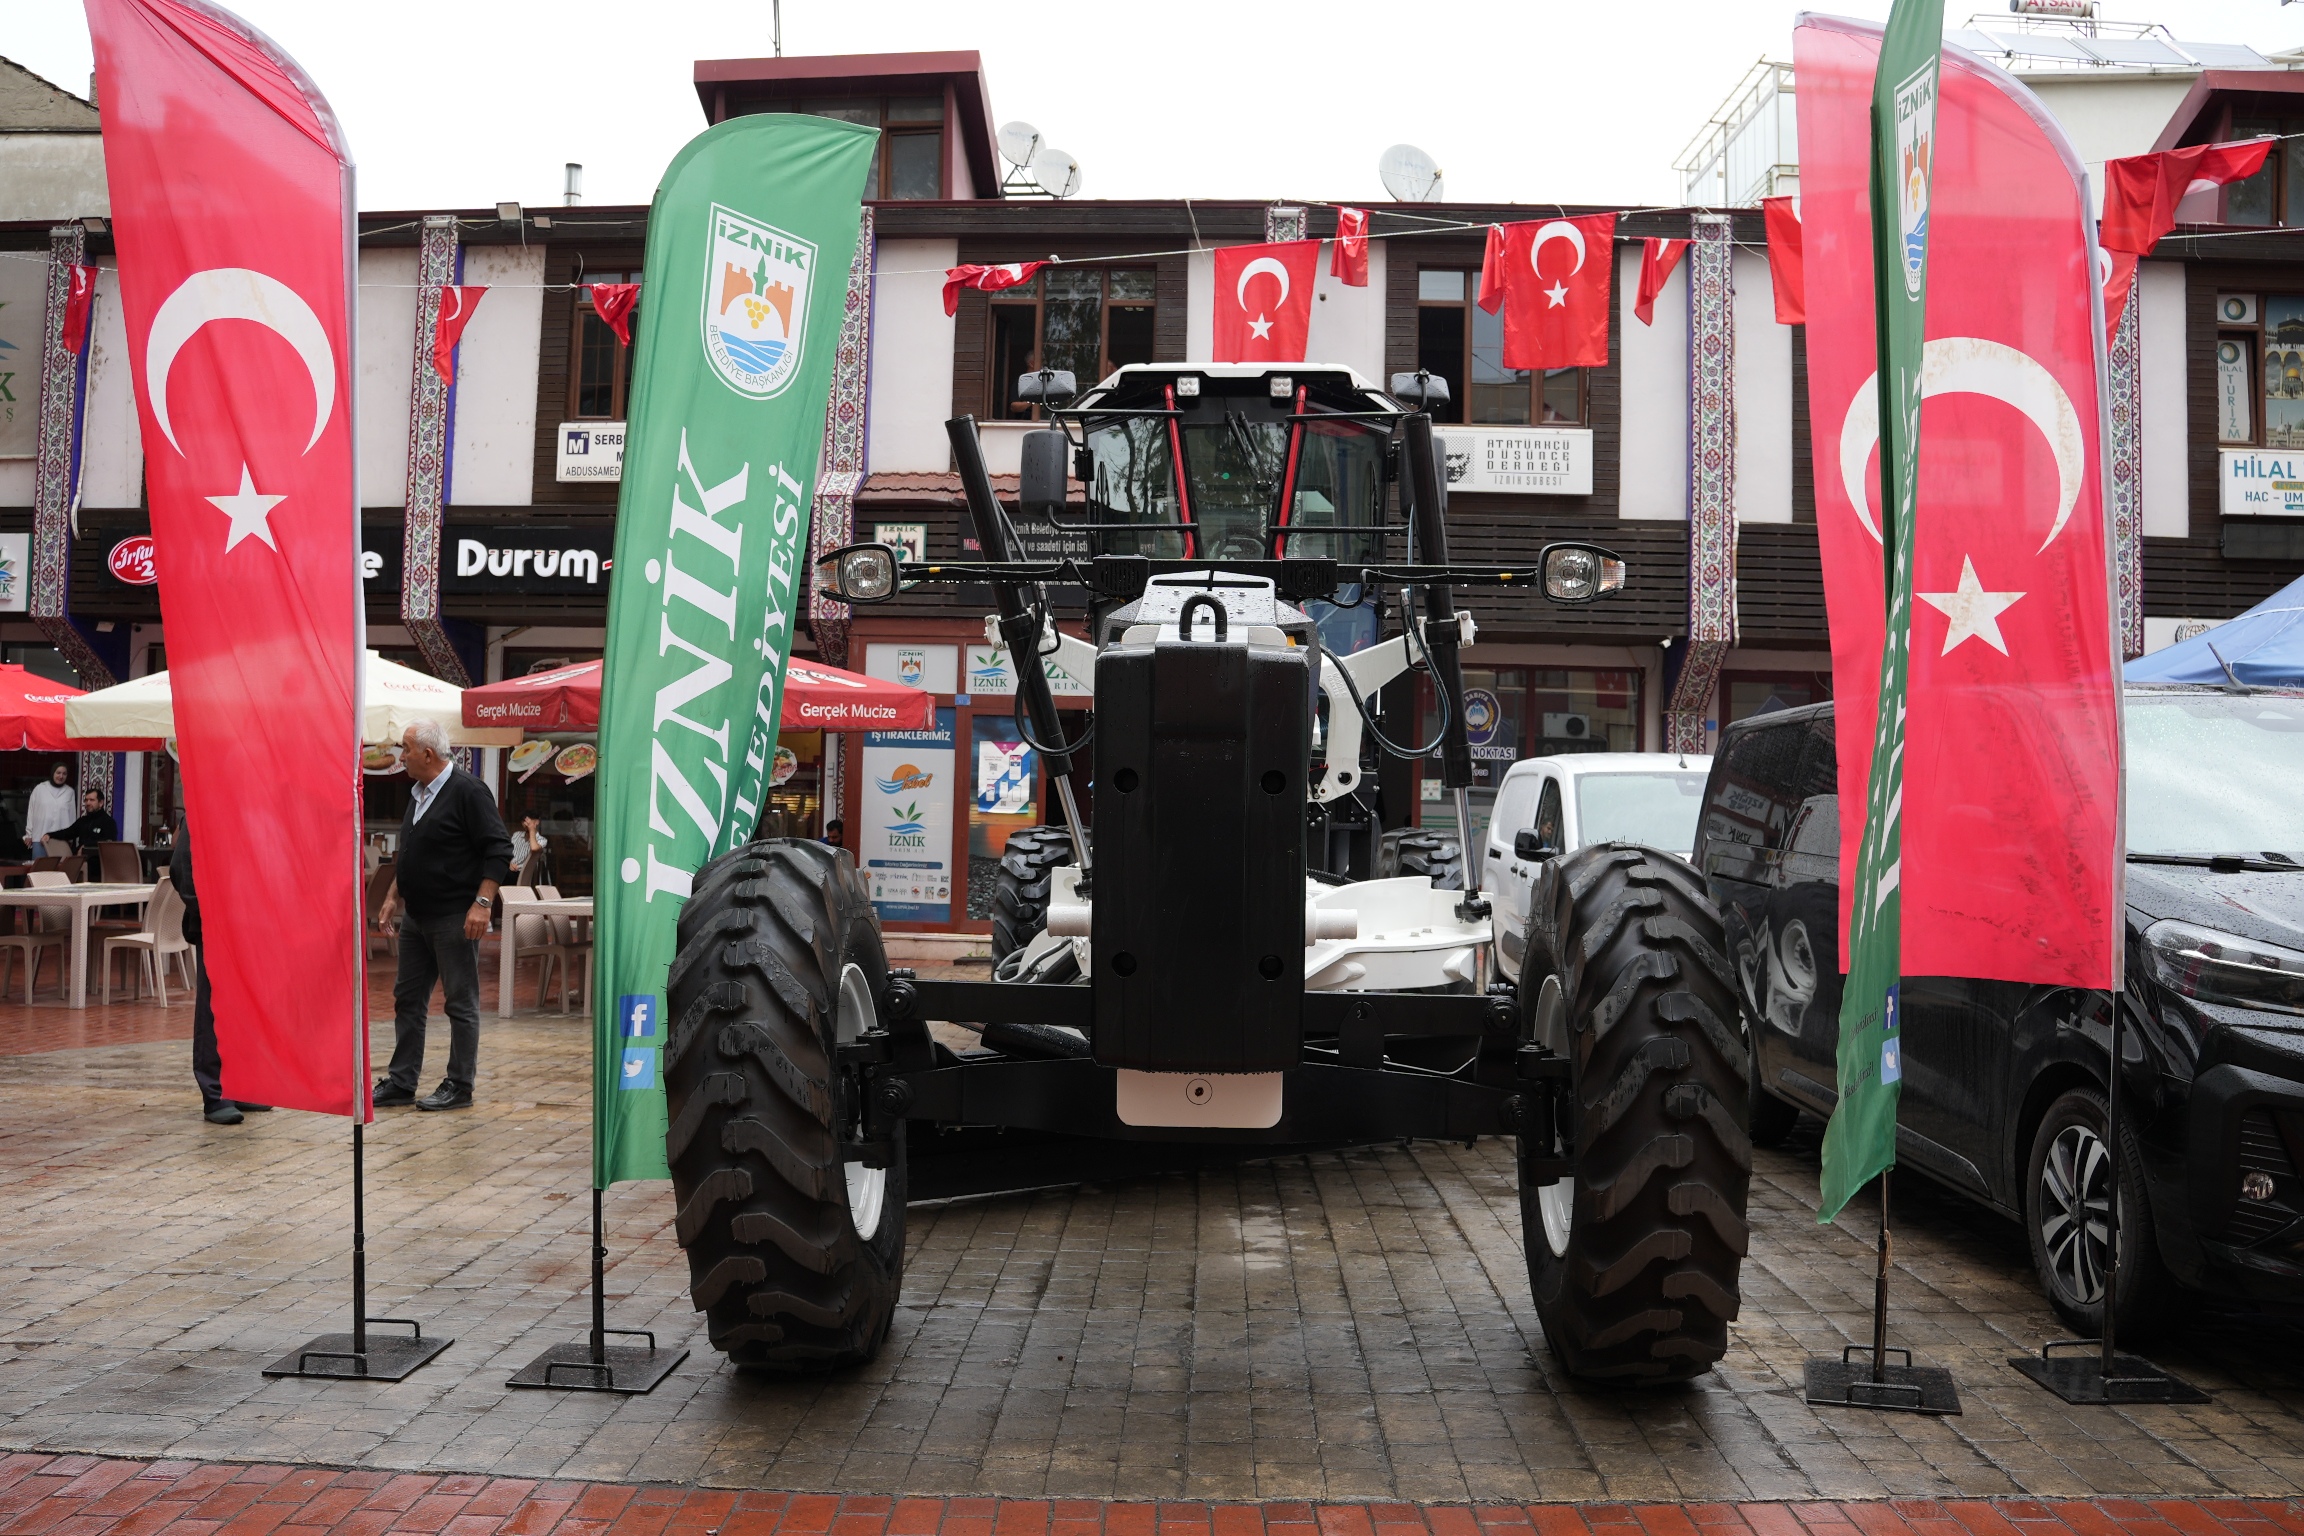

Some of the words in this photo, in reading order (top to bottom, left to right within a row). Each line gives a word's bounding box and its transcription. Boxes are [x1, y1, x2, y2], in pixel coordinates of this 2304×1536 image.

[709, 324, 743, 380] BELEDİYE
[745, 350, 794, 389] BAŞKANLIĞI
[2227, 374, 2241, 439] TURİZM
[1487, 439, 1570, 450] ATATÜRKÇÜ
[1487, 449, 1570, 461] DÜŞÜNCE
[565, 466, 621, 477] ABDUSSAMED
[2233, 455, 2297, 479] HİLAL
[2245, 491, 2269, 502] HAC
[963, 538, 981, 551] Mille
[730, 460, 803, 853] ELEDİYESİ
[973, 676, 1008, 688] İZNİK
[1054, 682, 1079, 690] RIM
[476, 703, 507, 720] Gerçek
[509, 702, 542, 717] Mucize
[800, 703, 848, 720] Gerçek
[851, 704, 897, 719] Mucize
[1471, 747, 1517, 760] NOKTASI
[888, 833, 926, 848] İZNİK
